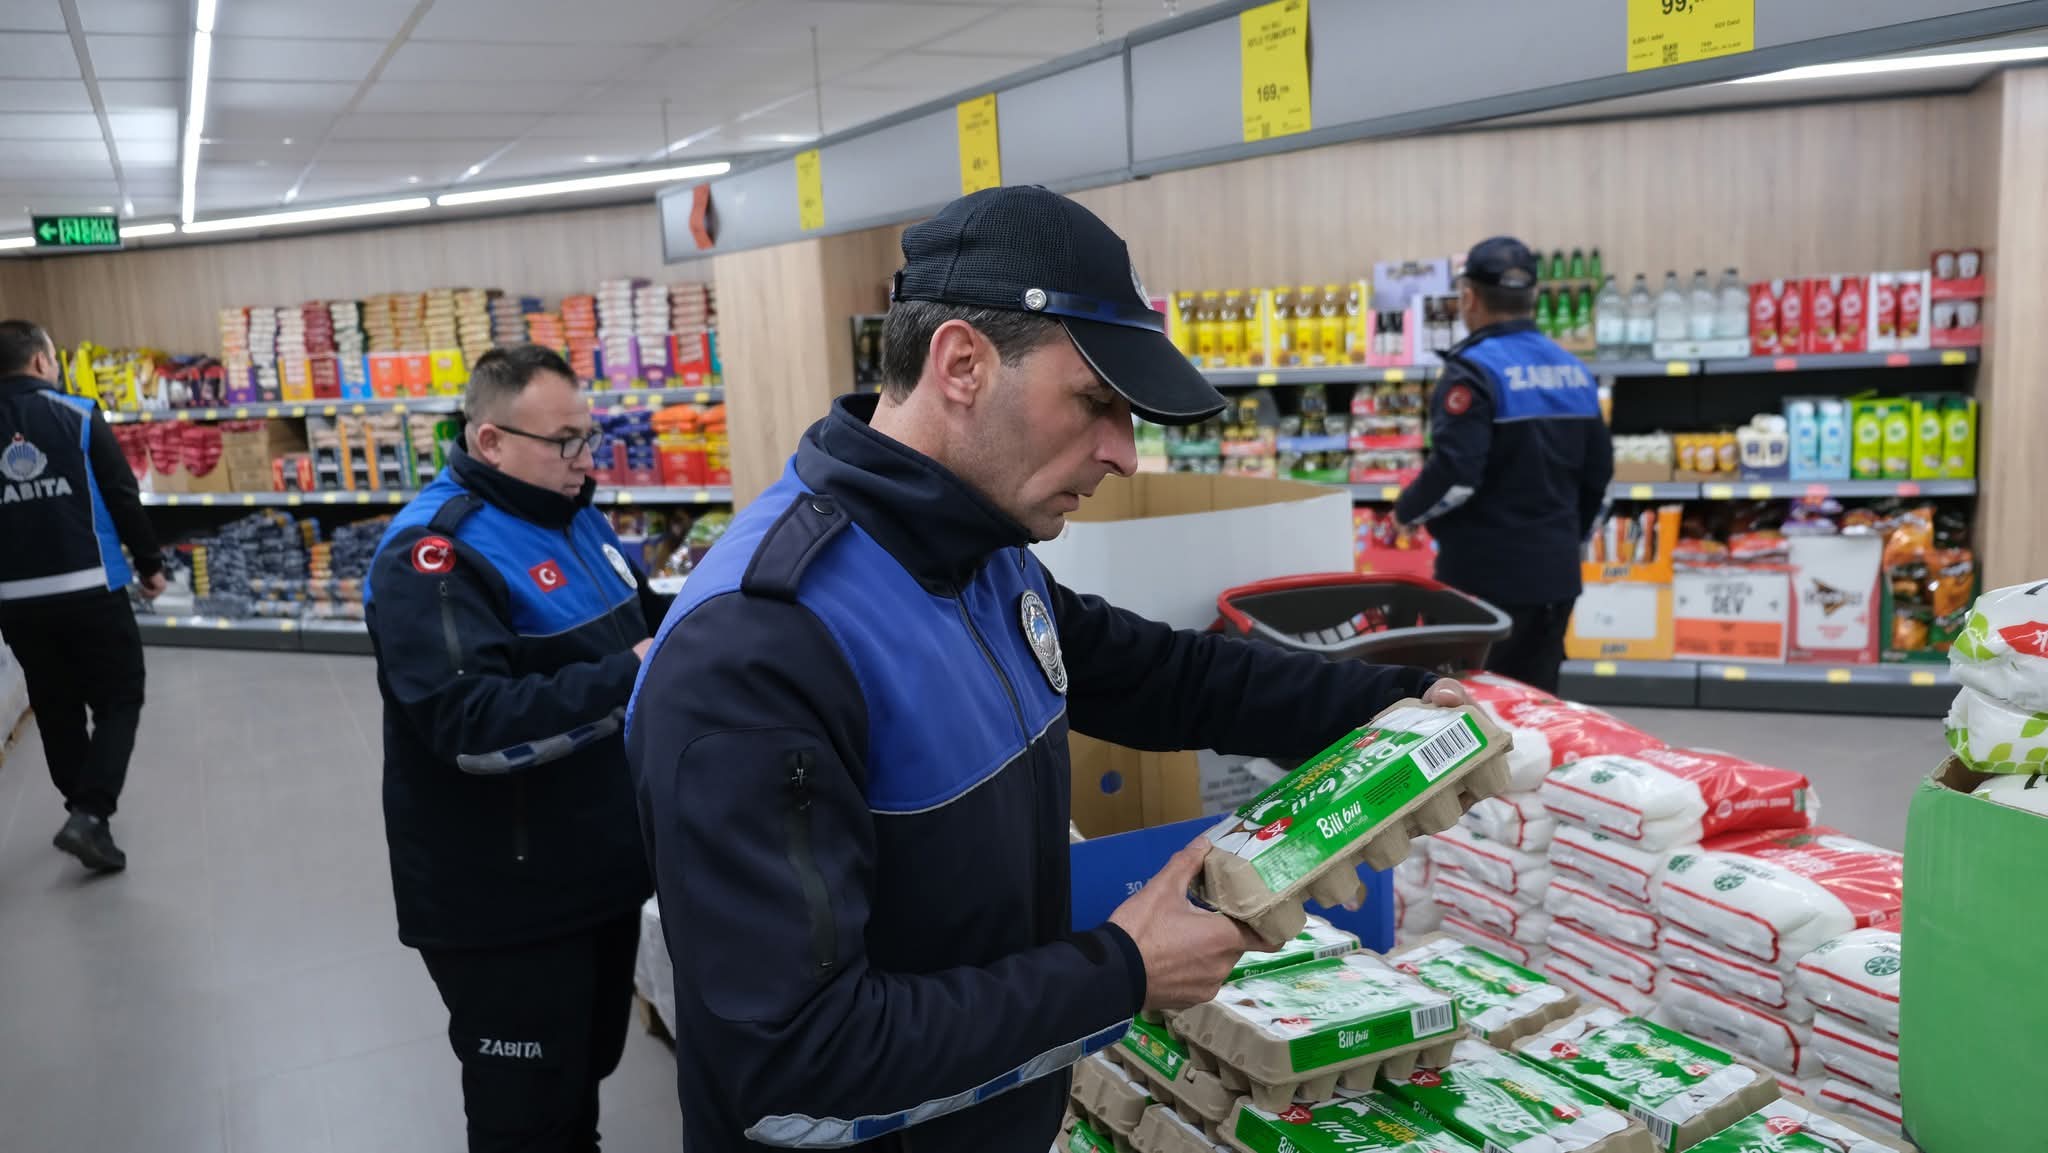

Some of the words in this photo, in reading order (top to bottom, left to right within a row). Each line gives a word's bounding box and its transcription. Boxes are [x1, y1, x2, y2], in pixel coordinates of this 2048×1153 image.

[1505, 365, 1590, 391] ZABITA
[0, 477, 73, 504] ABITA
[1316, 812, 1344, 839] Bili
[1342, 800, 1362, 824] bili
[479, 1038, 543, 1058] ZABITA
[1338, 1030, 1354, 1049] Bili
[1354, 1028, 1369, 1044] bili
